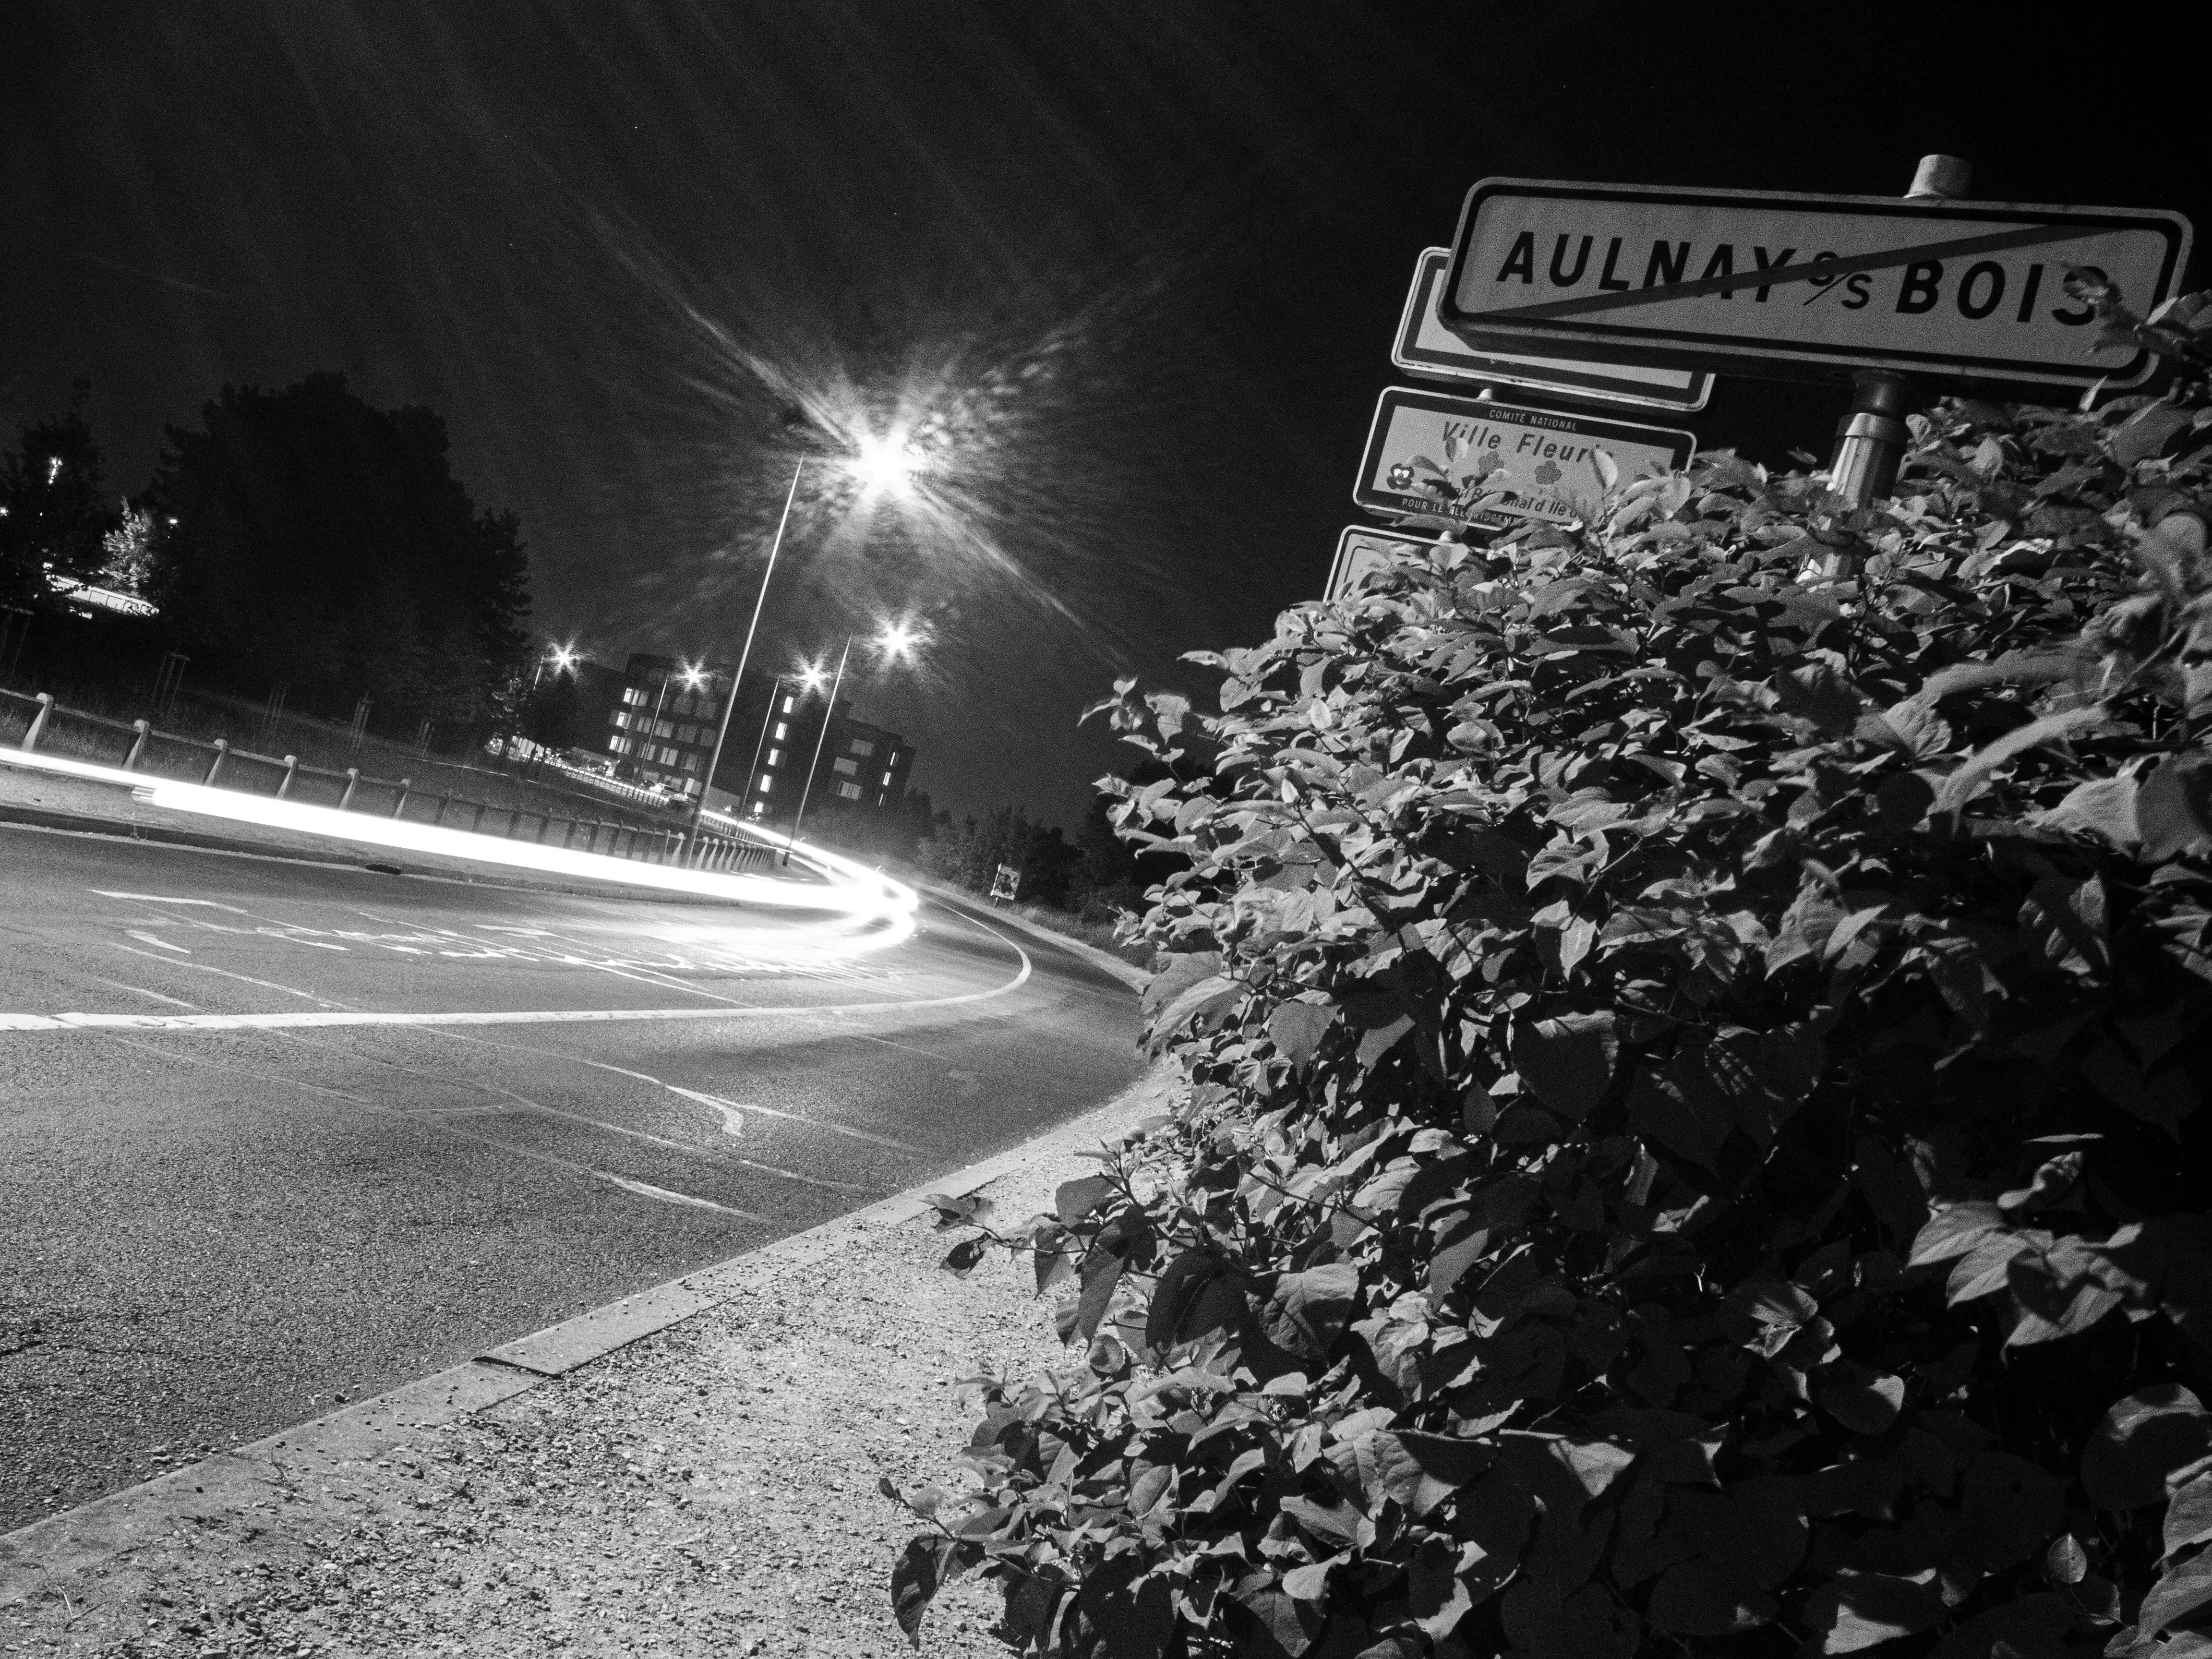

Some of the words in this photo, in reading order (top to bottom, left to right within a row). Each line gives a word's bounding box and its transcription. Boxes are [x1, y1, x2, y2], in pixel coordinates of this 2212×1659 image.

[1495, 231, 1797, 303] AULNAY
[1896, 259, 2108, 325] BOIS
[1489, 409, 1527, 423] COMITÉ
[1530, 415, 1576, 431] NATIONAL
[1443, 421, 1502, 448] Ville
[1401, 497, 1428, 510] POUR
[1433, 503, 1443, 513] LE
